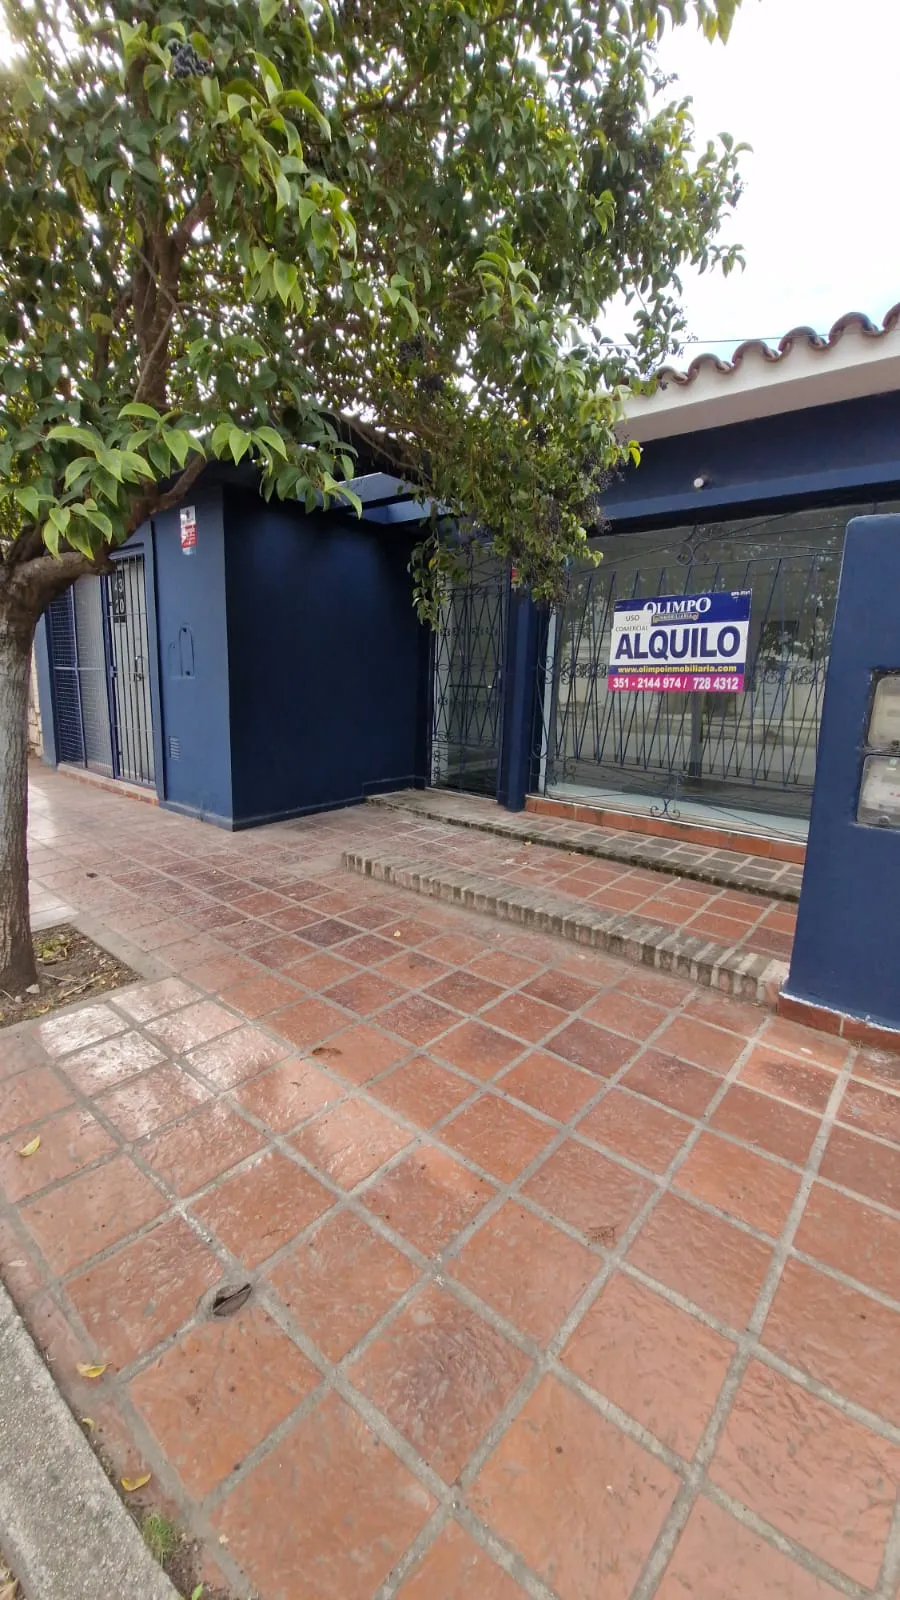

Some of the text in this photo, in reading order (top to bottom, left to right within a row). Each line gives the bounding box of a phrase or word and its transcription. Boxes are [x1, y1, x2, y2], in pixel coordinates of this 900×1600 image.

[643, 597, 711, 616] OLIMPO
[625, 614, 640, 622] USO
[615, 626, 741, 660] ALQUILO
[617, 664, 737, 674] www.olimpoinmobiliaria.com
[613, 677, 629, 688] 351
[637, 677, 661, 689] 2144
[662, 677, 681, 689] 974
[693, 677, 711, 690] 728
[712, 677, 739, 690] 4312
